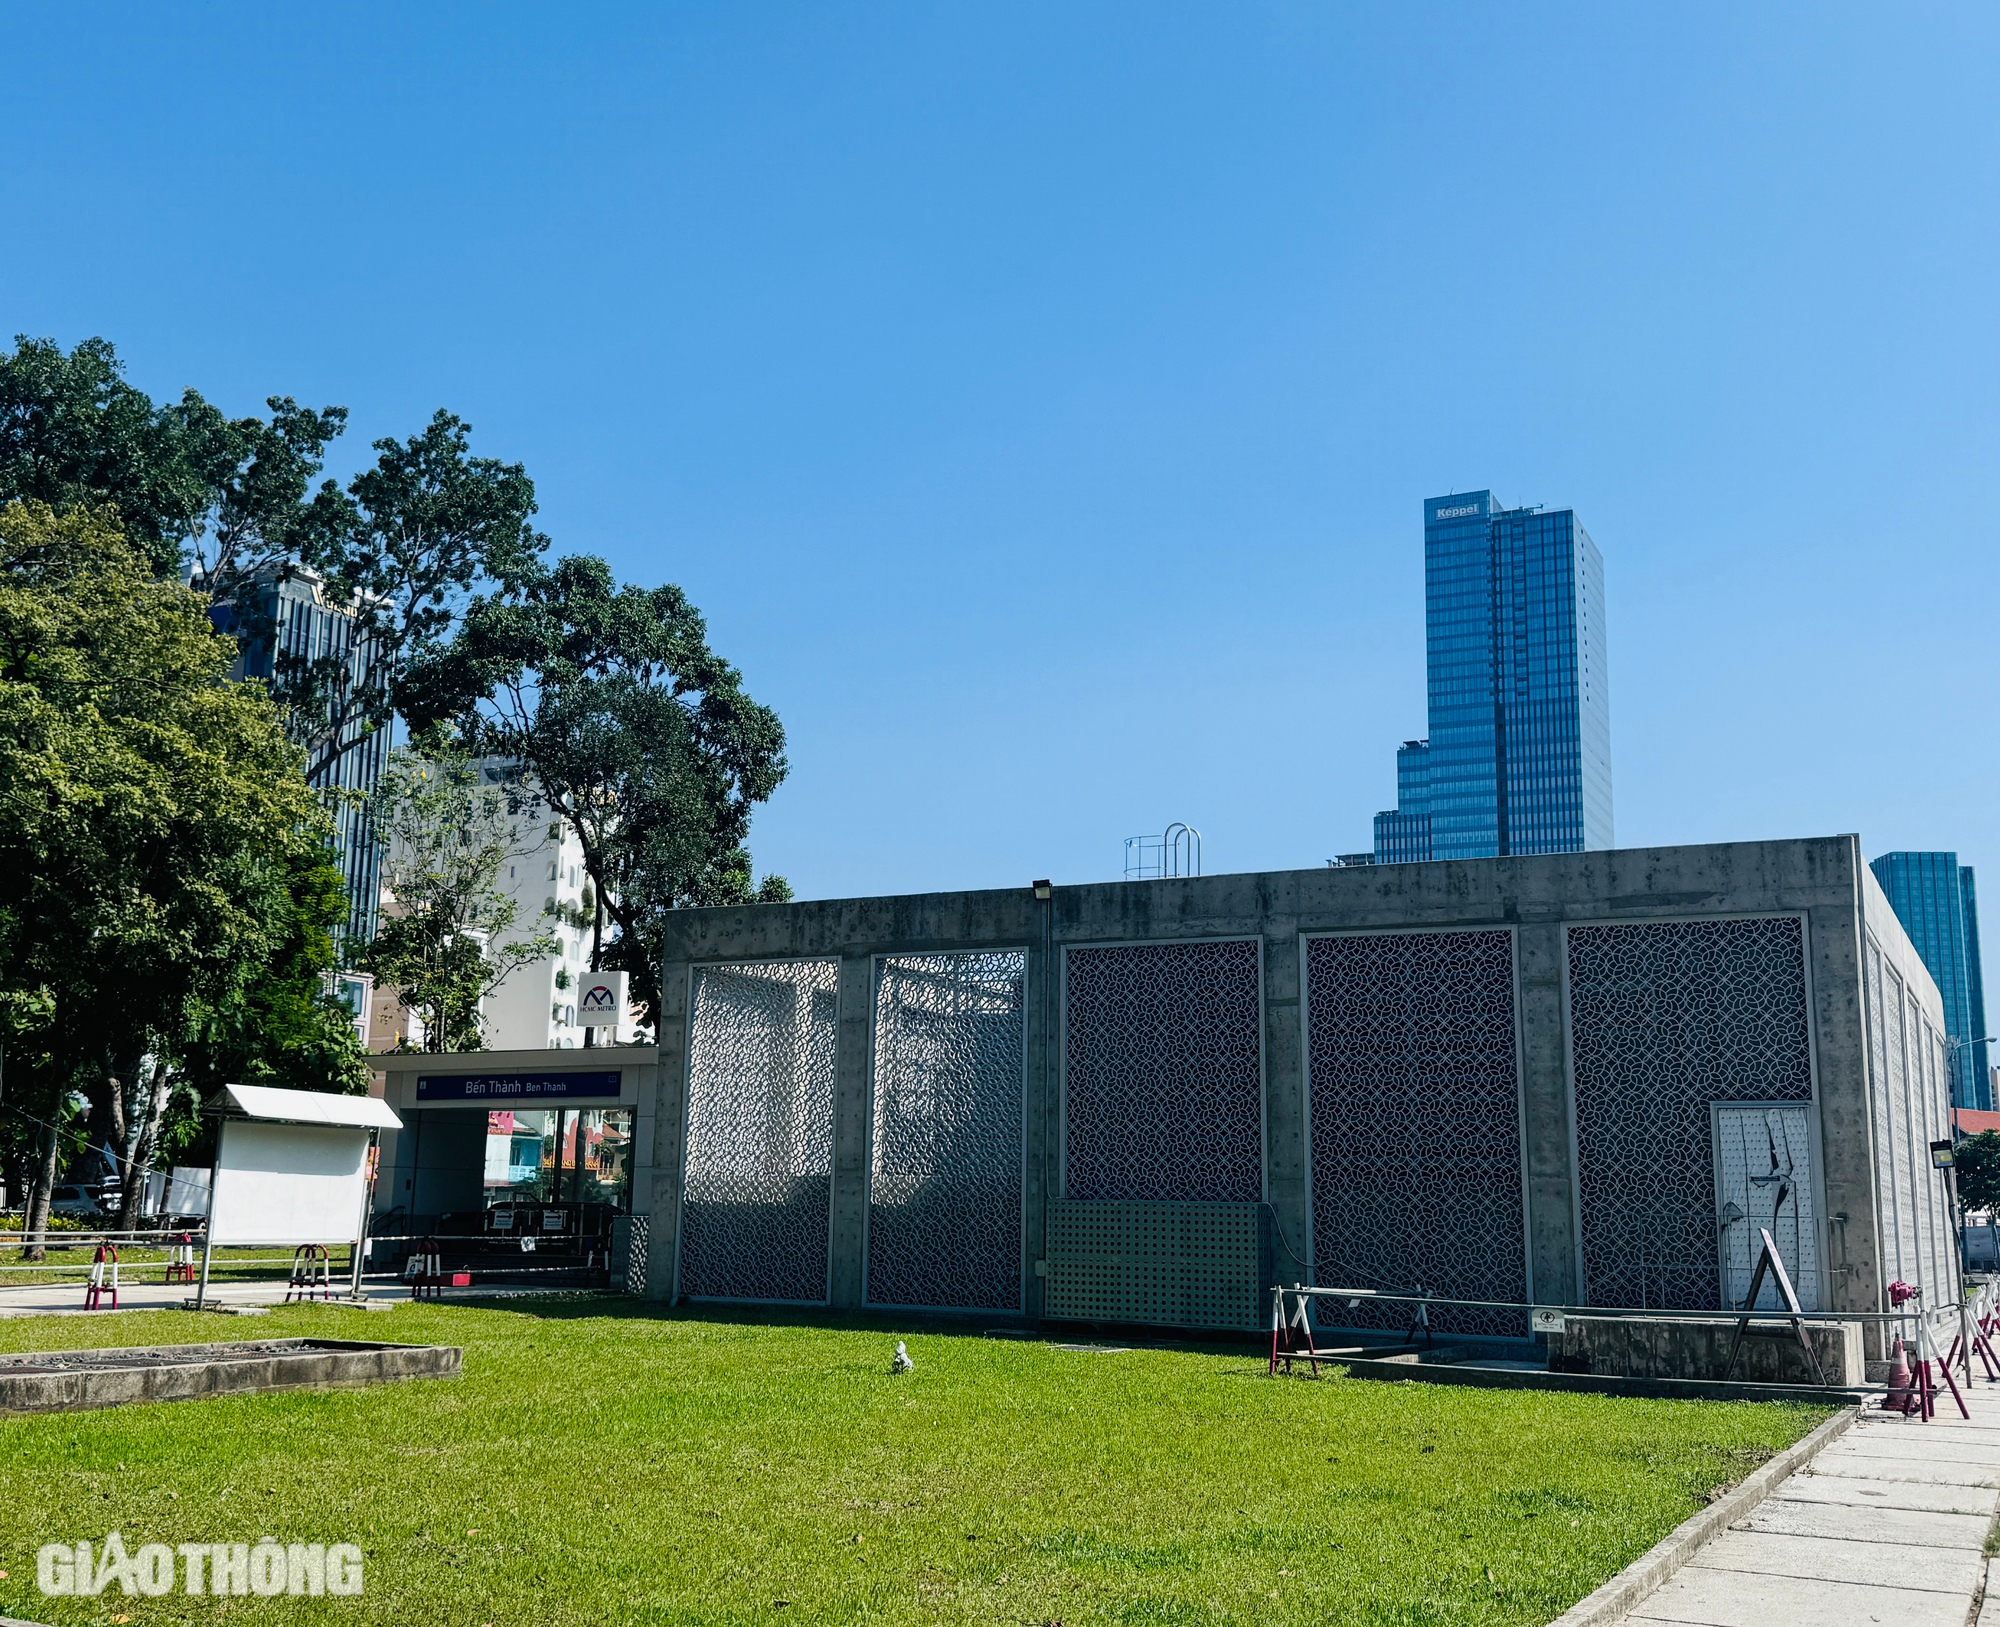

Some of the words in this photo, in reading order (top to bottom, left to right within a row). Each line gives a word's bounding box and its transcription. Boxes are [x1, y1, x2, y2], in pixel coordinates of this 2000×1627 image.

[1437, 503, 1478, 517] Keppel
[465, 1080, 486, 1094] Bến
[488, 1080, 521, 1093] Thành
[526, 1082, 541, 1092] Ben
[543, 1082, 567, 1092] Thanh
